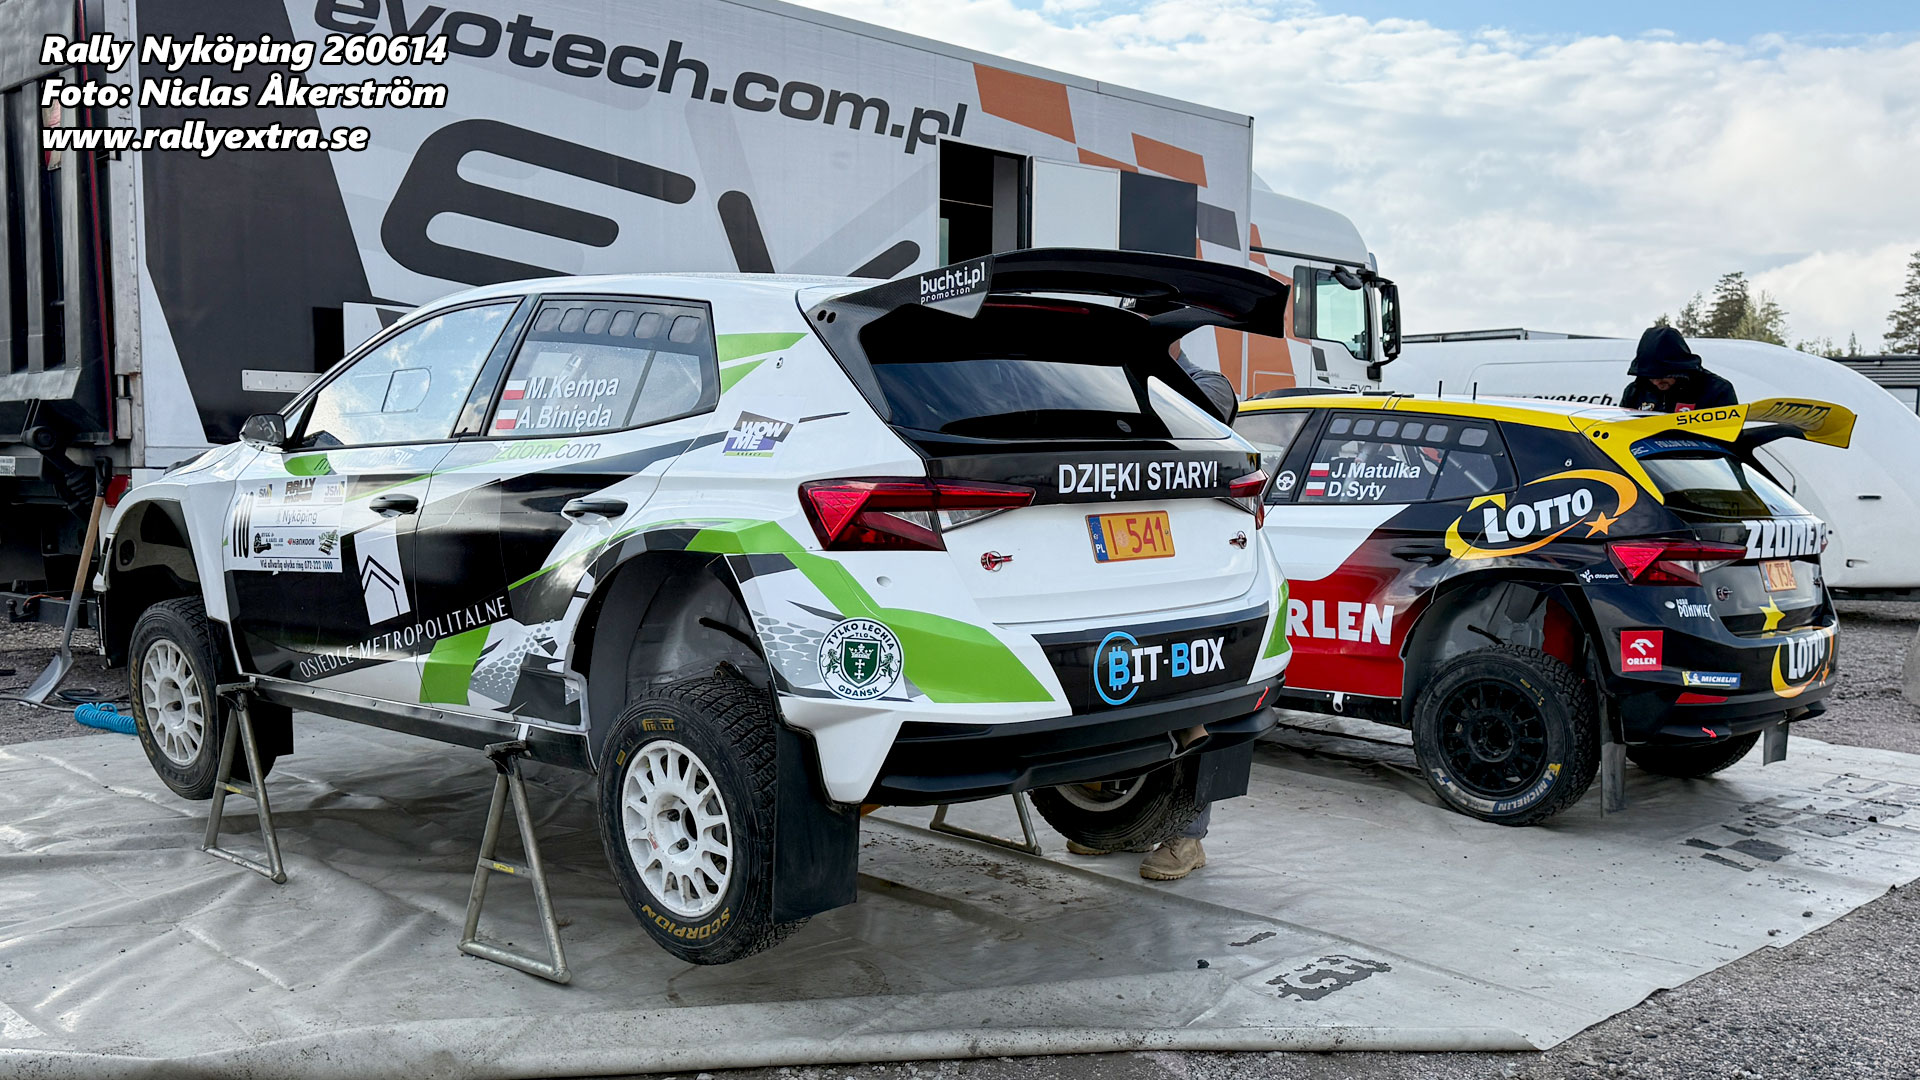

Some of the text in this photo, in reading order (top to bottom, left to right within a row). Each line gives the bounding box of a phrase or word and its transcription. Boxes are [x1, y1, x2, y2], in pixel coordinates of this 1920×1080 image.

[314, 0, 967, 154] evotech.com.pl
[920, 262, 985, 295] buchti.pl
[920, 286, 971, 305] promotion
[525, 376, 621, 402] M.Kempa
[515, 404, 613, 433] A.Binięda
[741, 420, 787, 438] WOW
[731, 436, 763, 450] ME
[1058, 460, 1218, 500] DZIĘKI STARY!
[1331, 462, 1421, 479] J.Matulka
[1327, 481, 1386, 500] D.Syty
[1483, 488, 1594, 544] LOTTO
[1127, 517, 1168, 554] 541
[1285, 598, 1394, 646] RLEN
[299, 596, 508, 678] OSIEDLE METROPOLITALNE
[826, 623, 895, 651] TYLKO LECHIA
[1626, 656, 1657, 666] ORLEN
[1786, 630, 1835, 680] LOTTO
[838, 684, 880, 697] GDAŃSK
[1701, 674, 1738, 684] MICHELIN
[642, 718, 675, 731] PIRLLI
[1498, 780, 1547, 812] MICHELIN
[641, 904, 731, 940] SCORPION
